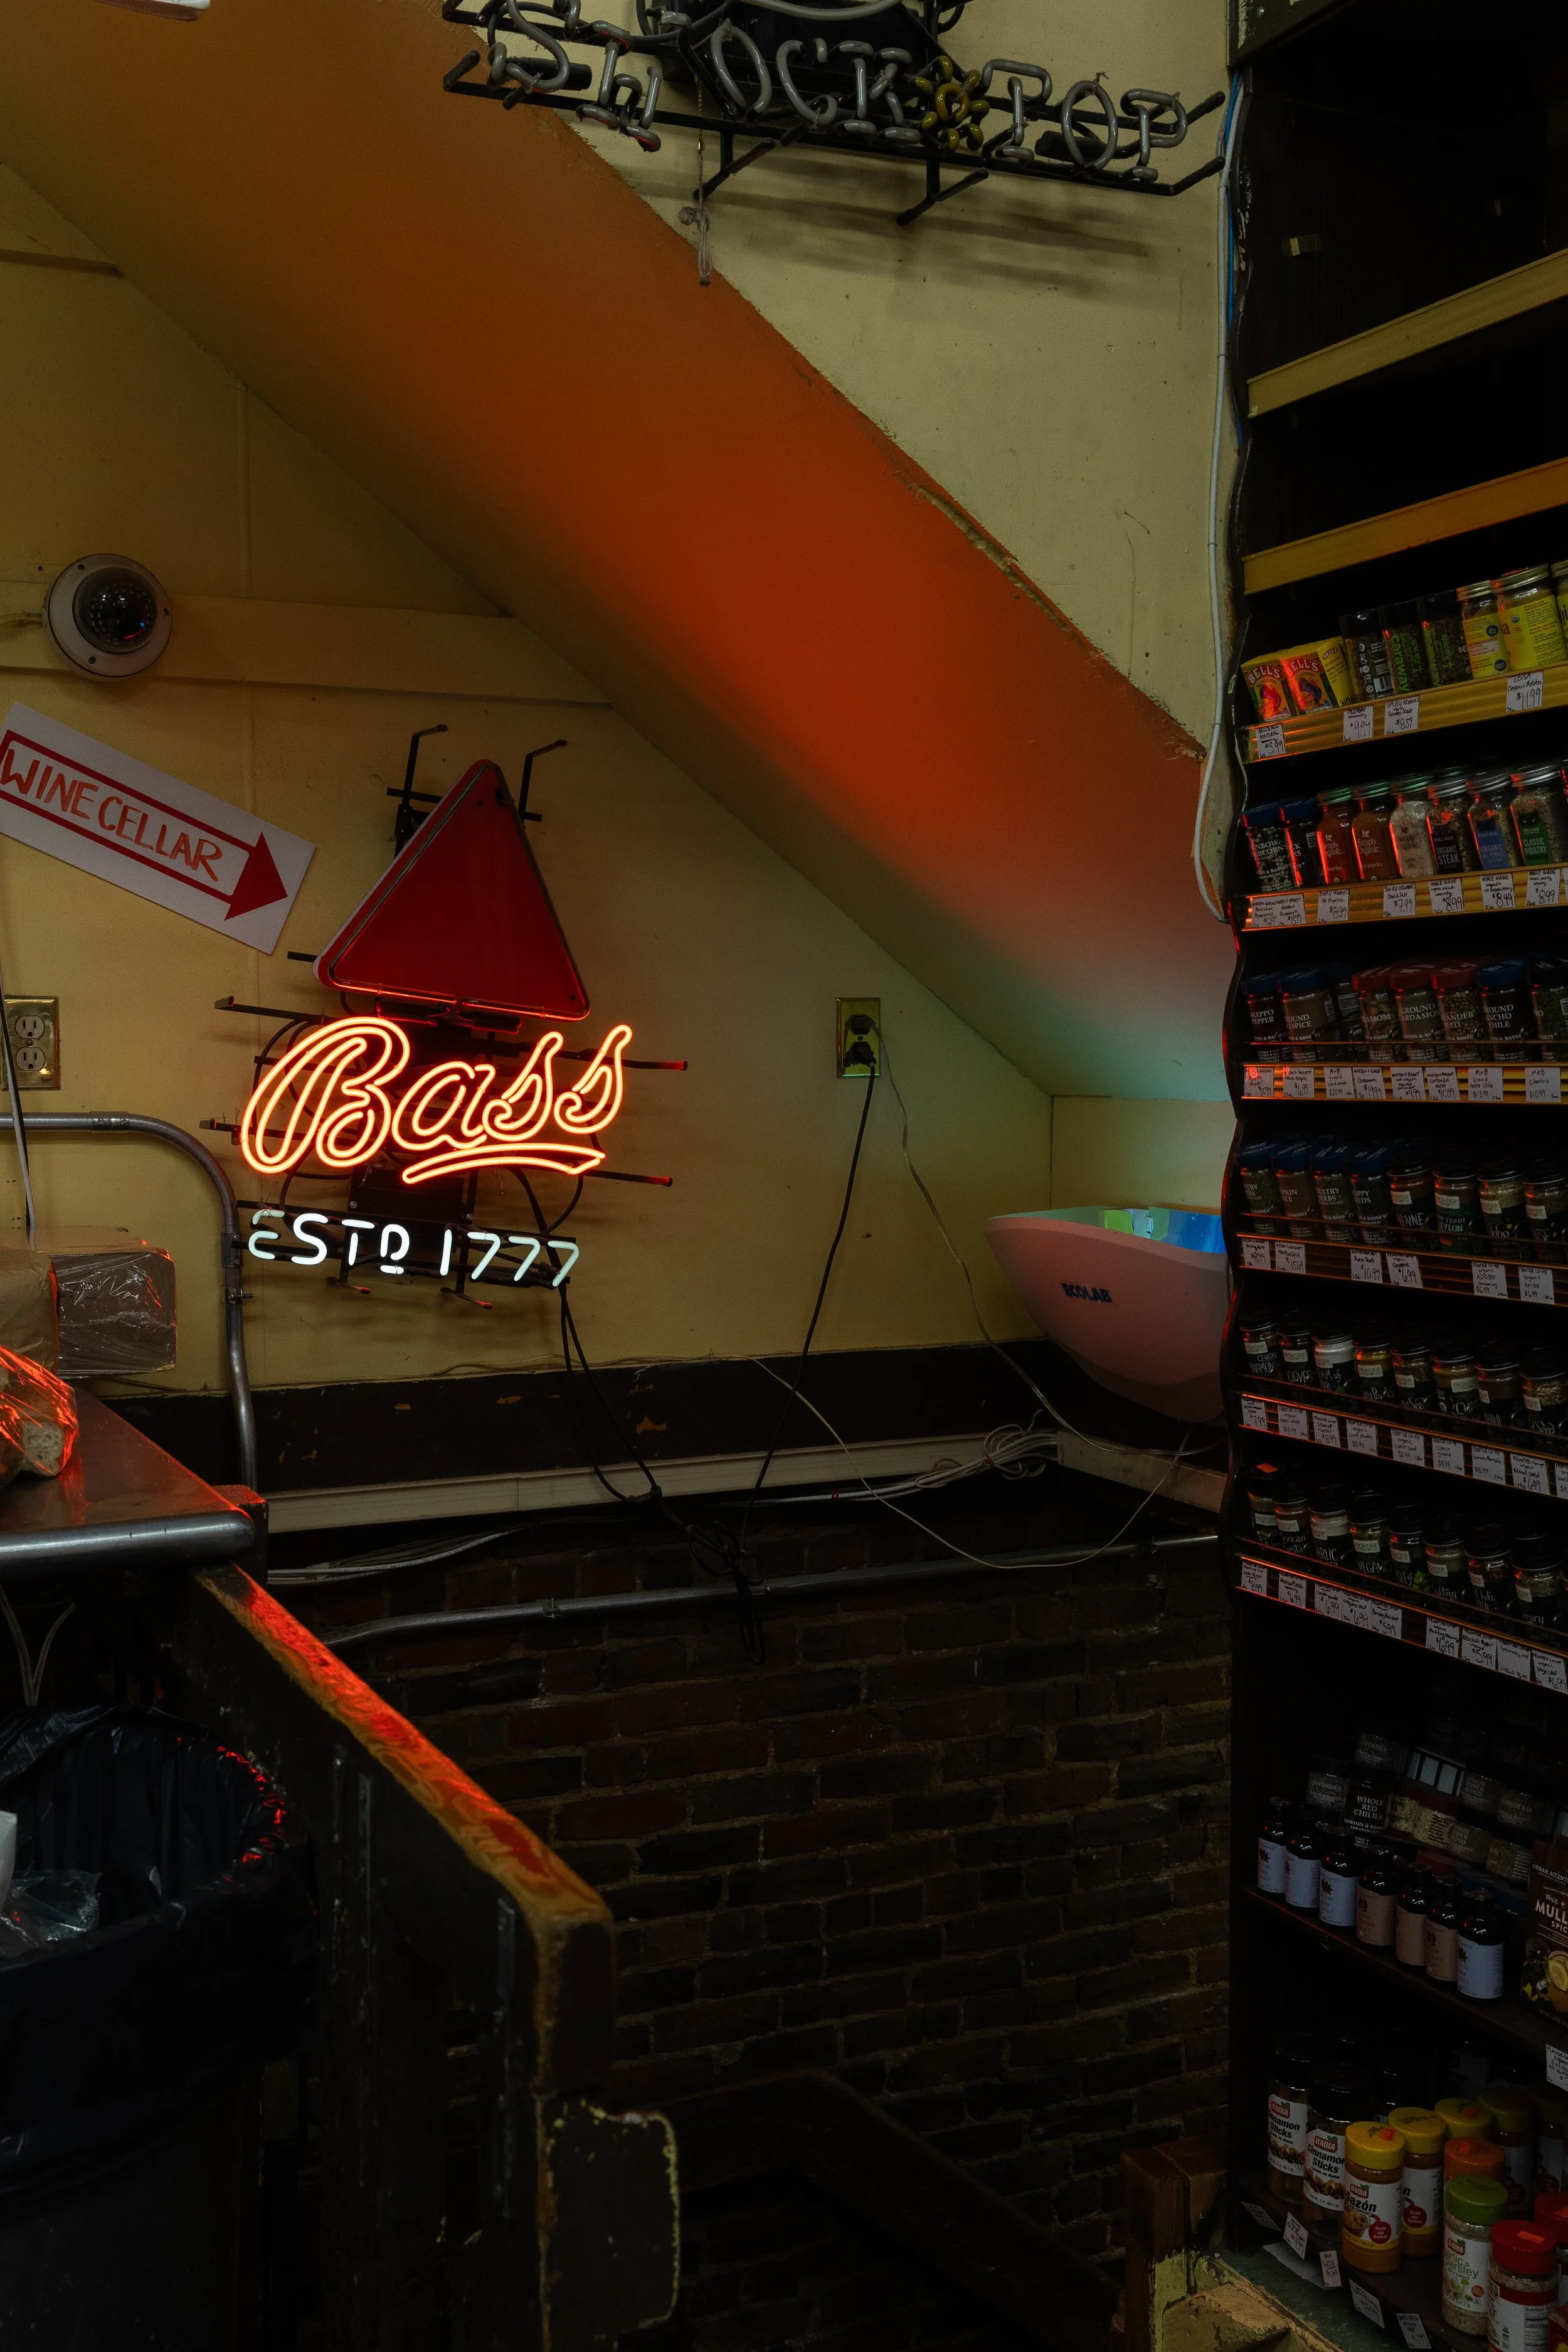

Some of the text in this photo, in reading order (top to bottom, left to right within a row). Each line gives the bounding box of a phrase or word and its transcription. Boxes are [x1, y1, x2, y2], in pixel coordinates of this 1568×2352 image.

[1285, 659, 1318, 676] BELL'S
[1391, 633, 1410, 692] caraway
[1248, 665, 1281, 684] BELL'S
[0, 749, 223, 882] WINE CELLAR
[1358, 838, 1377, 847] Simply
[1523, 837, 1545, 846] CLASSIC
[1436, 845, 1457, 855] ORGANIC
[1525, 845, 1547, 855] POULTRY
[1438, 854, 1460, 865] STEAK
[1250, 1009, 1274, 1018] ALEPPO
[1401, 1003, 1435, 1014] GROUND
[1251, 1016, 1274, 1024] PEPPER
[1402, 1010, 1439, 1022] ARDAMOM
[241, 1015, 633, 1175] Bass
[439, 1229, 580, 1288] 1777
[1061, 1283, 1112, 1303] ECOLAB
[1466, 1776, 1486, 1786] LEMON
[1465, 1786, 1483, 1797] BLEND
[1357, 1795, 1384, 1806] WHOLE
[1505, 1799, 1532, 1812] ARJORAM
[1353, 1809, 1383, 1820] CHILIES
[1344, 1818, 1364, 1827] MORTON
[1532, 1863, 1549, 1875] URBAN
[1545, 1894, 1559, 1905] WINE
[1535, 1899, 1568, 1926] MULL
[1551, 1920, 1568, 1934] SPIC
[1271, 2102, 1288, 2116] BADIA
[1270, 2121, 1292, 2138] Sticks
[1315, 2137, 1335, 2151] BADIA
[1312, 2157, 1339, 2173] Sticks
[1350, 2185, 1367, 2197] BADIA
[1346, 2191, 1377, 2213] Sazón
